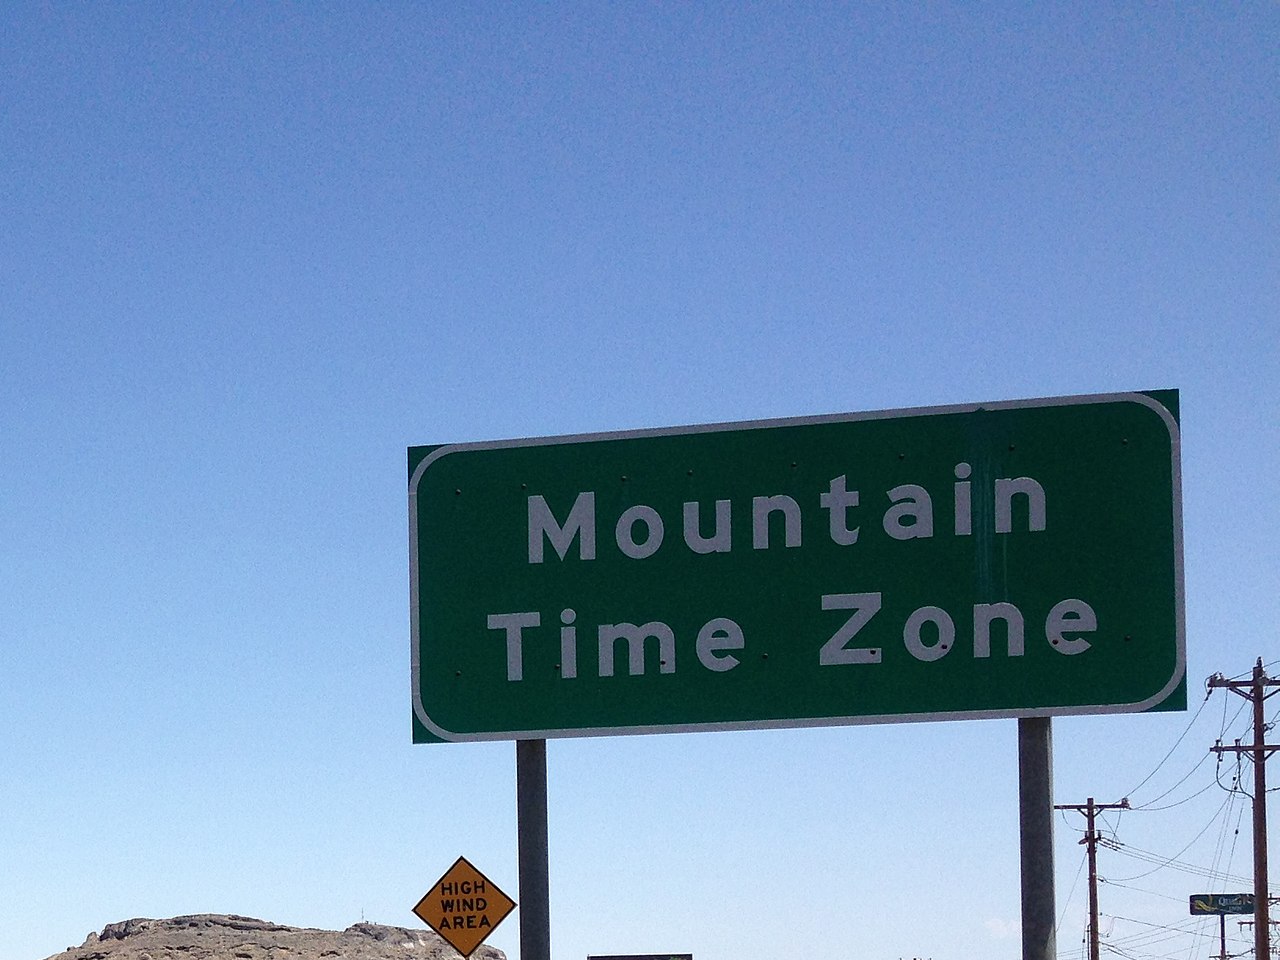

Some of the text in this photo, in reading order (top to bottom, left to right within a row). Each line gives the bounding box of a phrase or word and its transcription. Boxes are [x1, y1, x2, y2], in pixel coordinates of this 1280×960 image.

[527, 461, 1047, 564] Mountain
[486, 591, 1098, 682] Time Zone
[441, 880, 486, 896] HIGH
[441, 898, 488, 913] WIND
[439, 915, 492, 930] AREA
